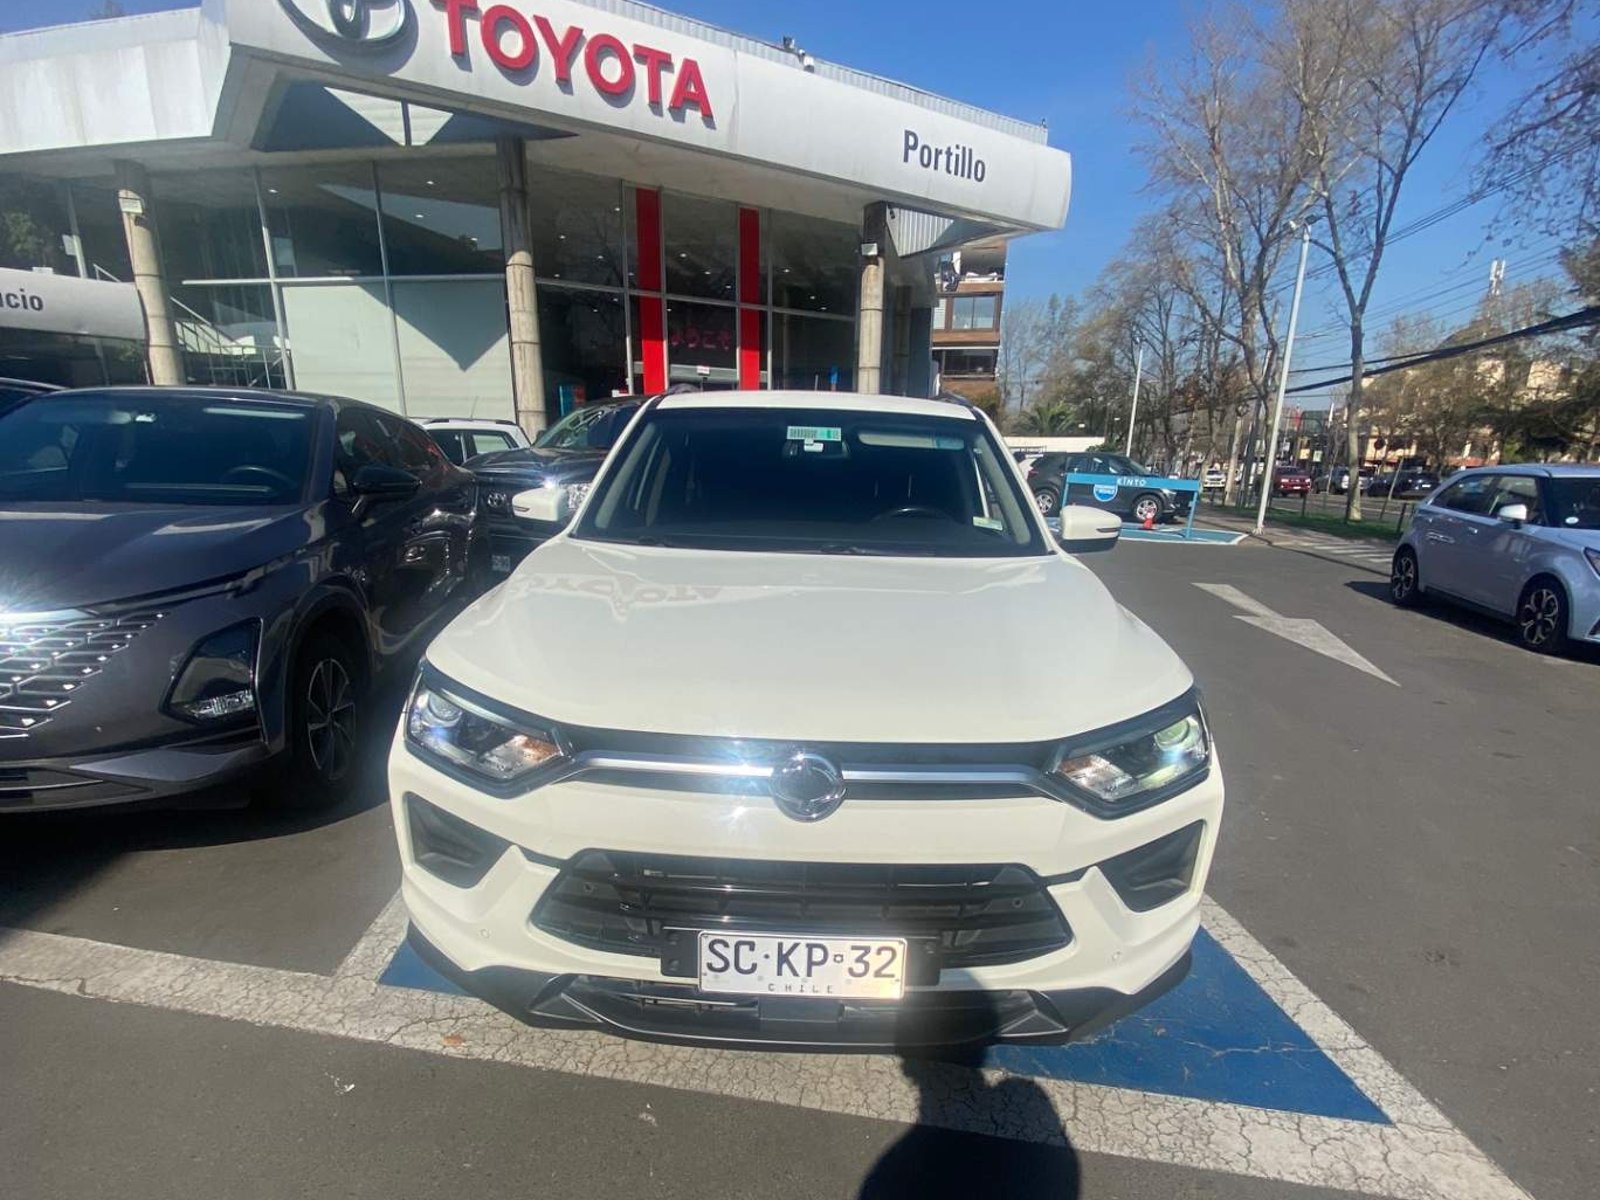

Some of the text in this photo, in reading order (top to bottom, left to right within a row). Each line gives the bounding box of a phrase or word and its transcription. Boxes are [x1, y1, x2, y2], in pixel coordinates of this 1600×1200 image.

[440, 0, 713, 118] TOYOTA
[903, 129, 986, 183] Portillo
[768, 983, 833, 994] CHILE
